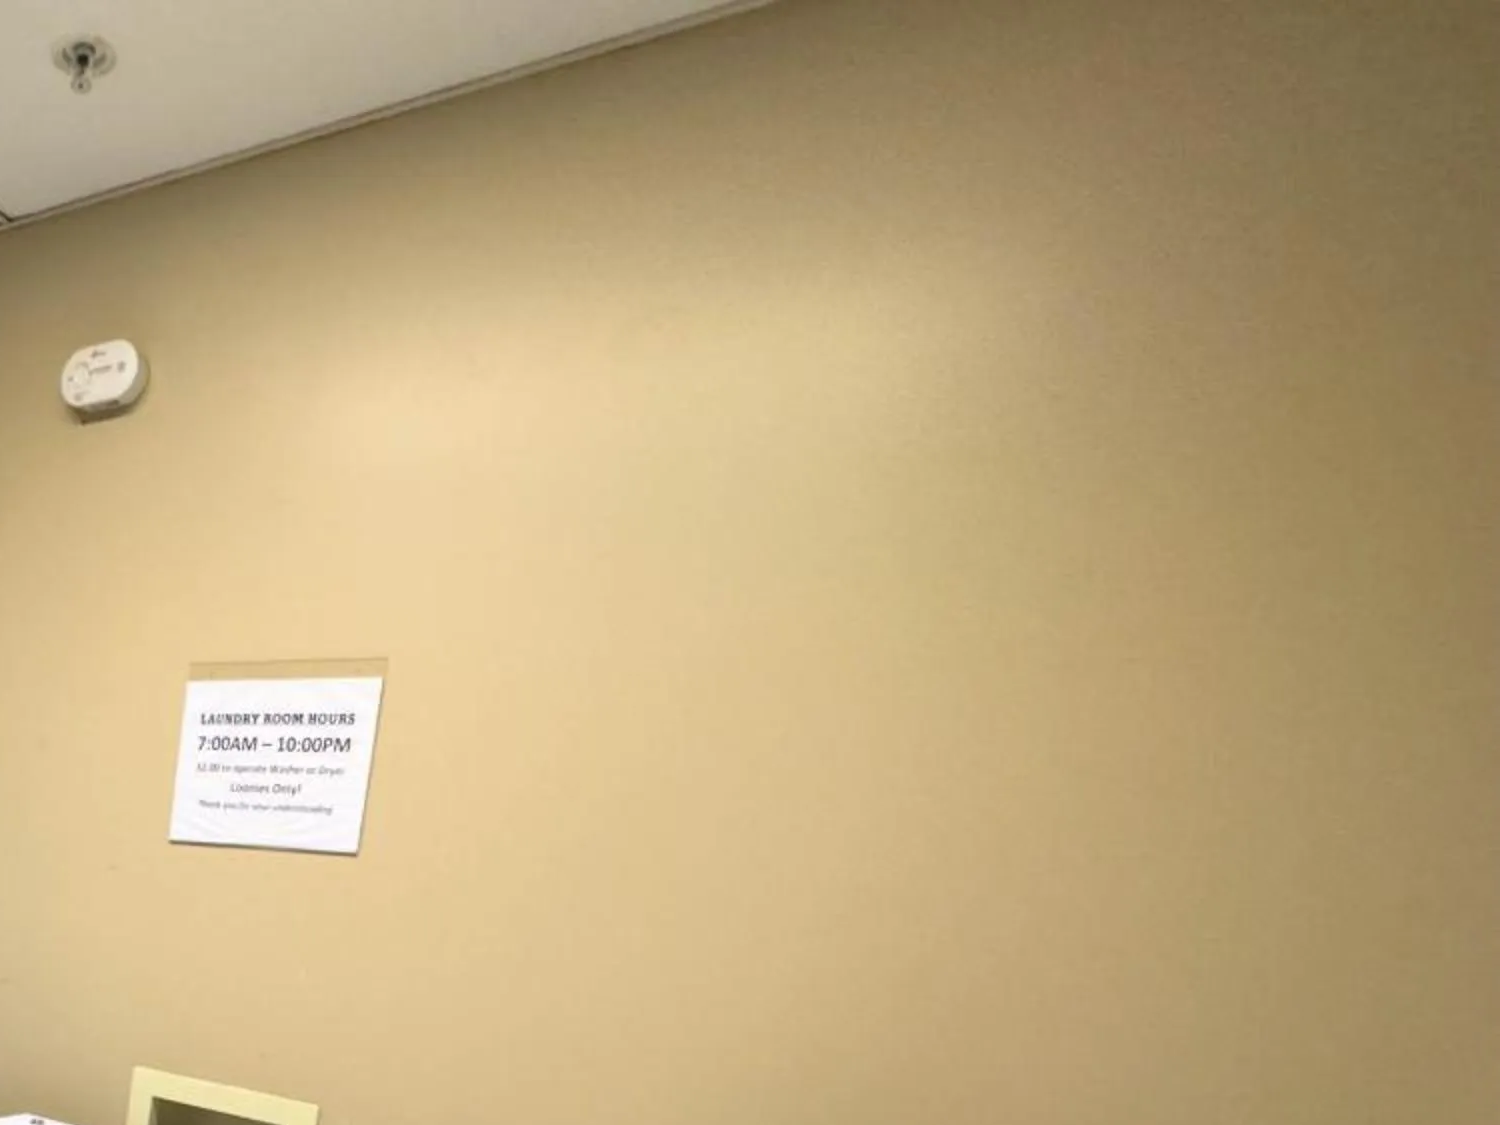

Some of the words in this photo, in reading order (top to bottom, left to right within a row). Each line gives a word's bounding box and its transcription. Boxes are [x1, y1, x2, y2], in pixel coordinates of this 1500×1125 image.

[200, 713, 260, 725] LAUNDRY
[263, 713, 304, 725] ROOM
[308, 713, 355, 725] HOURS
[197, 736, 258, 751] 7:00AM
[277, 737, 351, 752] 10:00PM
[269, 764, 304, 775] Washer
